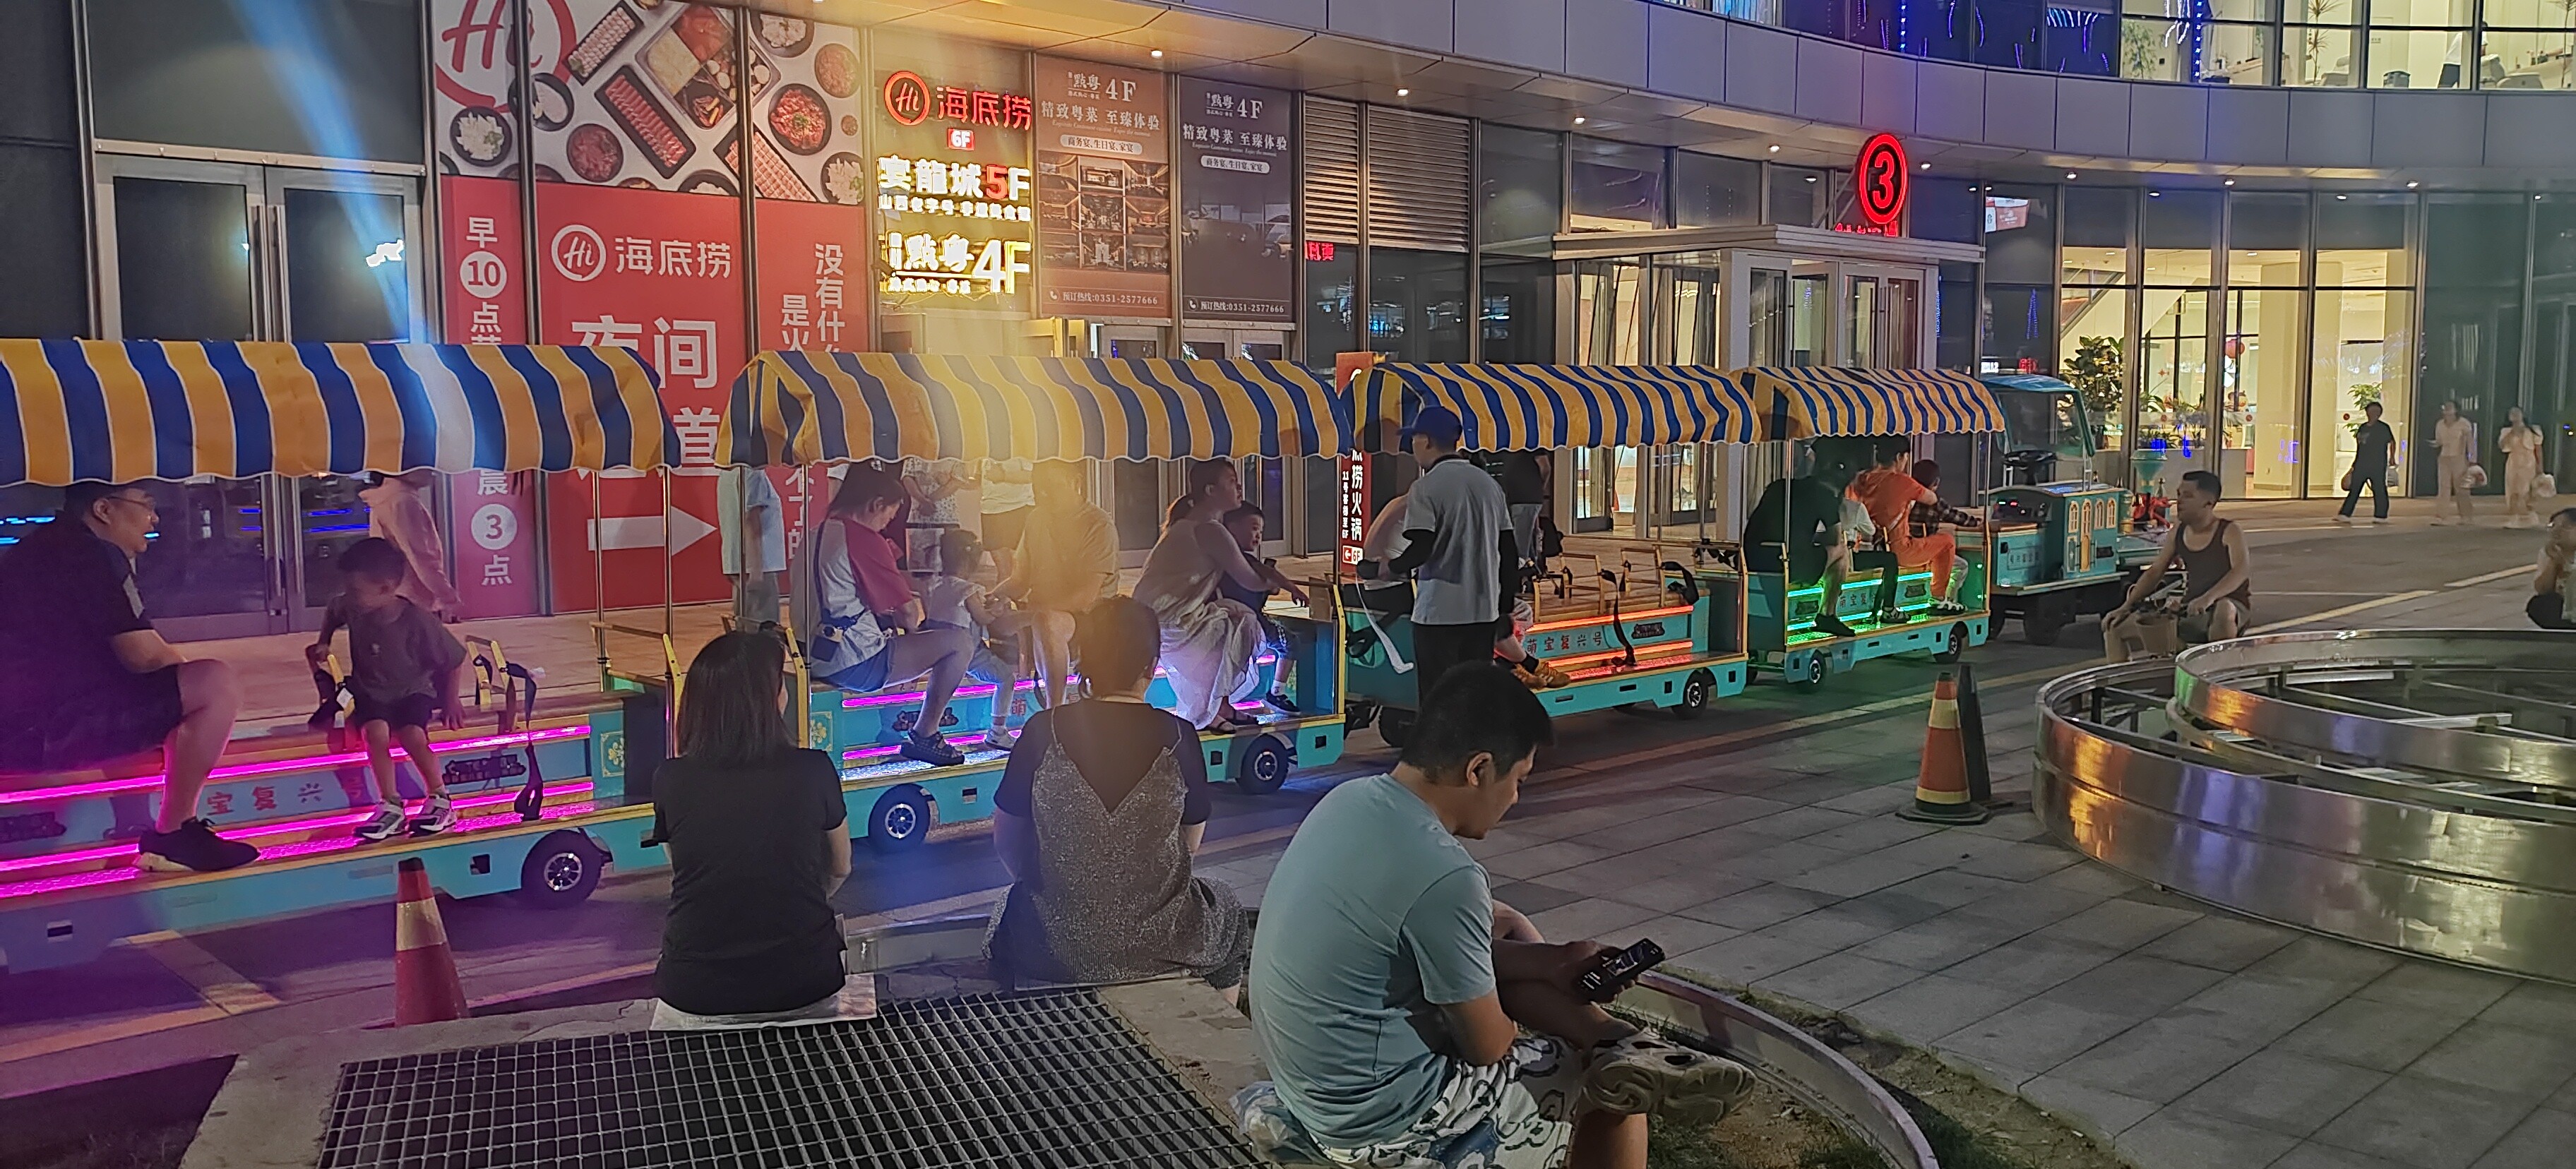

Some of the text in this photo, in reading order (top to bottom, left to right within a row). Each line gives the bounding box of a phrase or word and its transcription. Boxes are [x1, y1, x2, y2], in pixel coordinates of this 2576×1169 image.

[1105, 78, 1137, 102] 4F
[936, 86, 1032, 131] 海底捞
[1041, 101, 1098, 123] 精致粤菜
[1105, 109, 1160, 131] 至臻体验
[1237, 99, 1263, 119] 4F
[952, 130, 971, 148] 6F
[1183, 124, 1234, 145] 精致粤菜
[1872, 151, 1895, 209] 3
[616, 236, 731, 279] 海底捞
[1526, 632, 1603, 654] 萌宝复兴号
